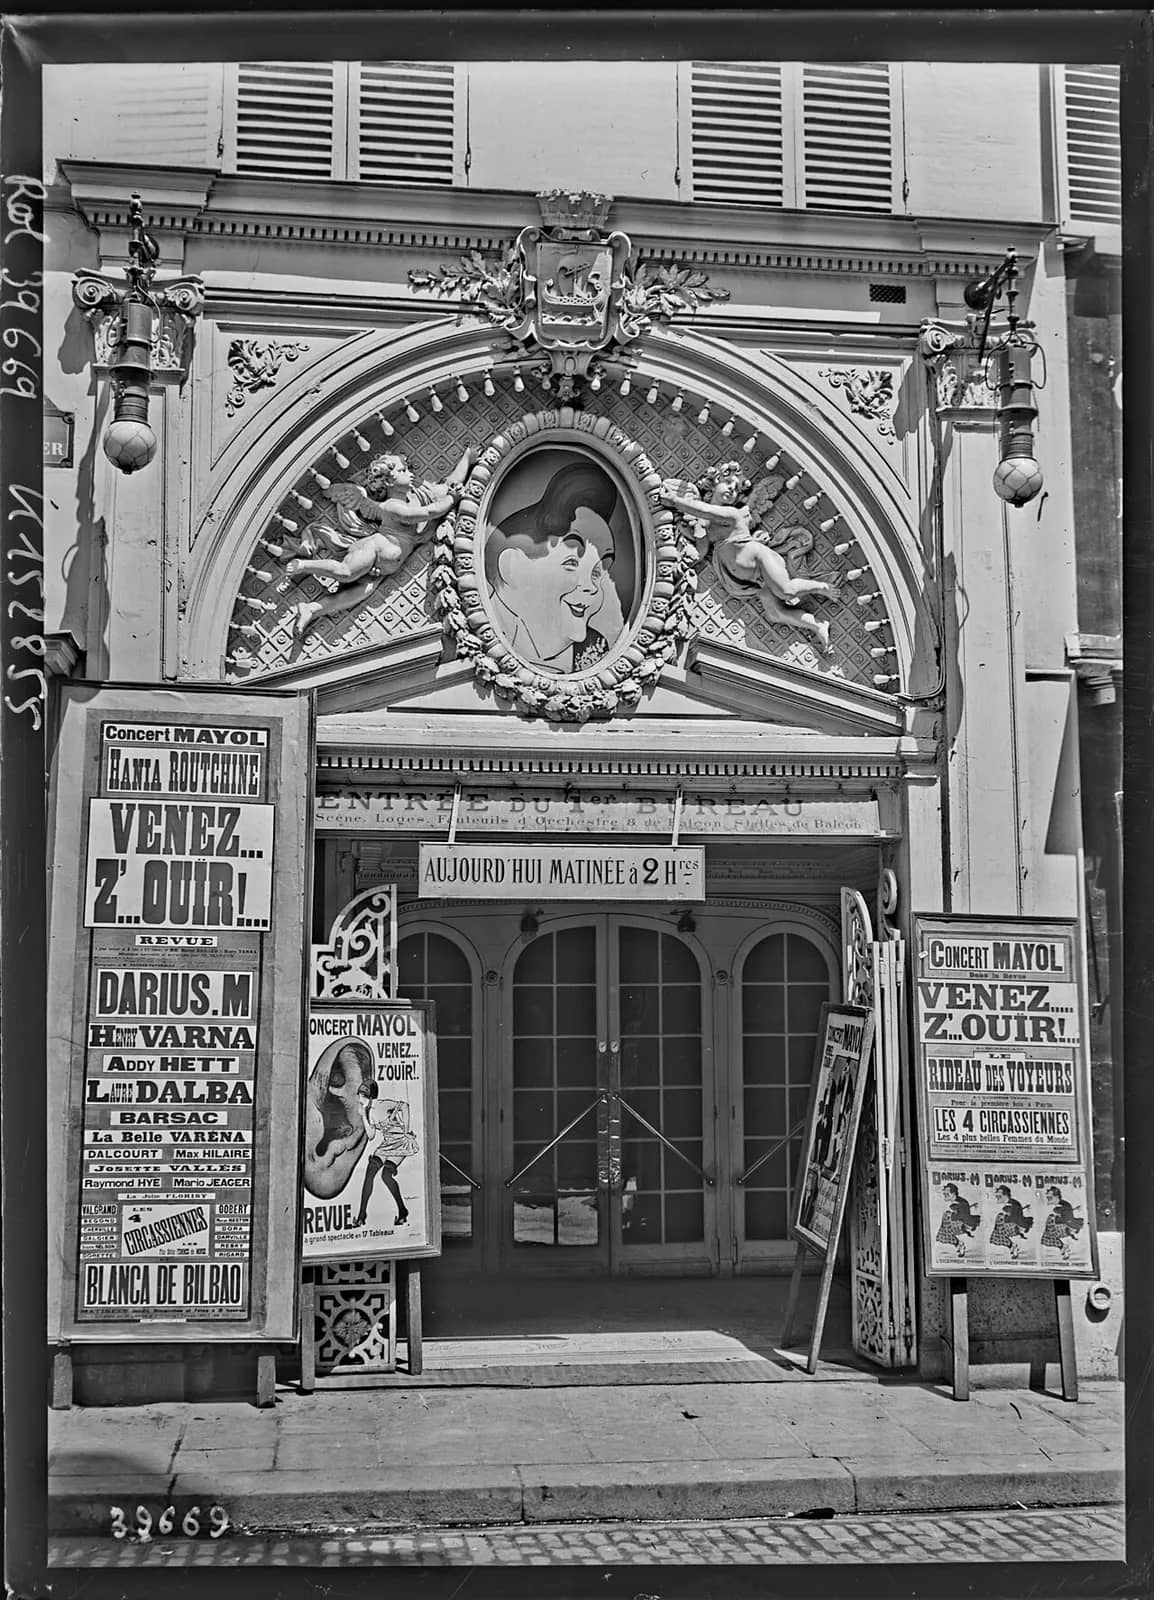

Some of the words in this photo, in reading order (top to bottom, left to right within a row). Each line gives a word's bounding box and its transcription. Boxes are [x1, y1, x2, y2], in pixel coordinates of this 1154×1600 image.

[105, 725, 171, 742] Concert
[174, 728, 265, 746] MAYOL
[168, 751, 259, 795] ROUTCHINE
[317, 790, 489, 812] ENTRÉE
[510, 797, 551, 813] DU
[636, 797, 803, 816] BUREAU
[438, 815, 509, 825] Futeuils
[424, 857, 542, 884] AUJOURD'HUI
[549, 857, 625, 884] MATINÉE
[642, 858, 659, 884] 2
[140, 936, 214, 946] REVUE
[992, 942, 1063, 972] MAYOL
[356, 1014, 417, 1036] MAYOL
[138, 1025, 255, 1049] VARNA
[159, 1056, 236, 1072] HETT
[928, 1058, 981, 1091] RIDEAU
[985, 1064, 1005, 1092] DES
[1006, 1060, 1073, 1094] VOYEURS
[135, 1080, 253, 1104] DALBA
[119, 1112, 219, 1124] BARSAC
[935, 1109, 957, 1132] LES
[962, 1110, 974, 1132] 4
[979, 1110, 1069, 1134] CIRCASSIENNES
[92, 1131, 113, 1143] La
[121, 1131, 163, 1143] Belle
[962, 1134, 977, 1142] plus
[1003, 1134, 1033, 1143] Femmes
[88, 1150, 159, 1159] DALCOURT
[175, 1149, 200, 1158] Max
[202, 1149, 250, 1158] HILAIRE
[85, 1179, 134, 1189] Raymond
[137, 1179, 161, 1187] HYE
[174, 1178, 204, 1187] Mario
[128, 1214, 141, 1223] 4
[304, 1204, 352, 1234] REVUE
[124, 1206, 208, 1255] CIRCASSIENNES
[328, 1232, 354, 1243] spectacle
[362, 1230, 368, 1238] 17
[87, 1265, 150, 1305] BLANCA
[157, 1265, 178, 1305] DE
[183, 1264, 241, 1304] BILBAO
